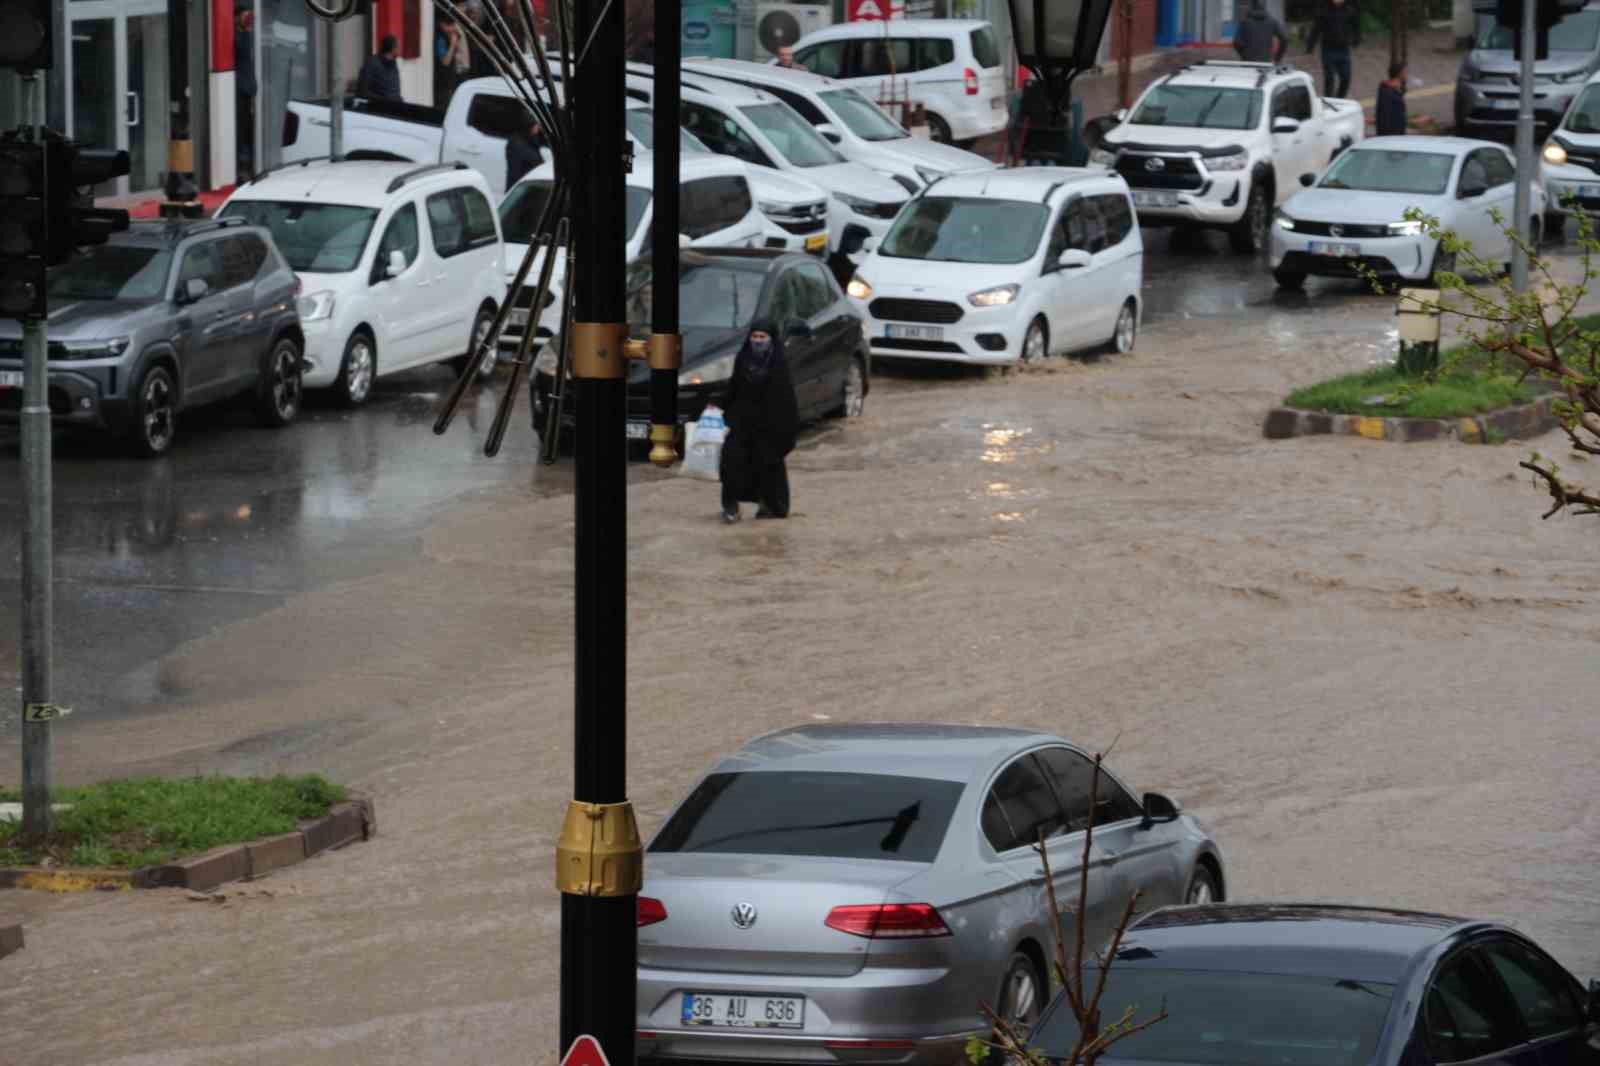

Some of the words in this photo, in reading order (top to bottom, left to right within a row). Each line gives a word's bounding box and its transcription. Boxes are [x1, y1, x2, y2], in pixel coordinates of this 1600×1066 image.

[694, 997, 713, 1017] 36
[727, 998, 747, 1018] AU
[765, 1000, 795, 1020] 636
